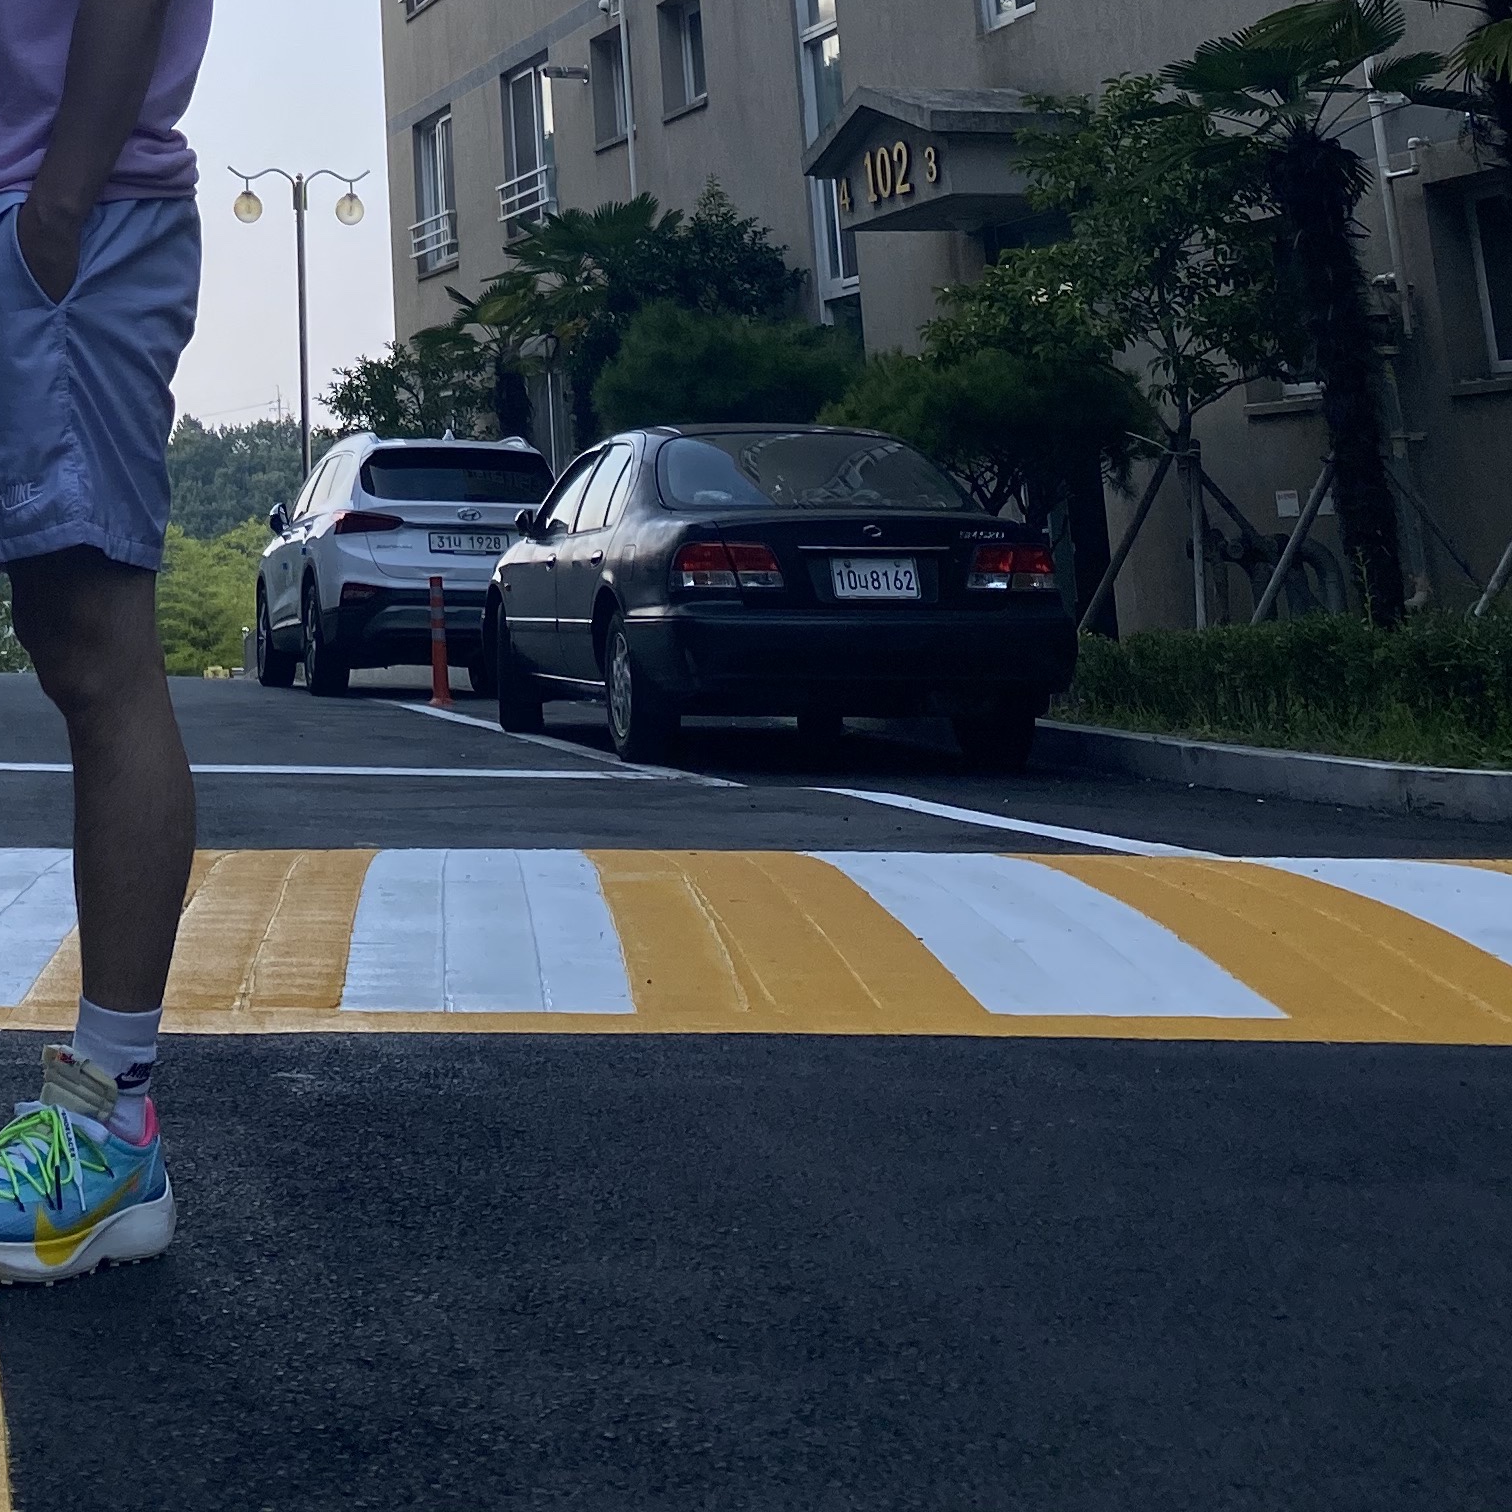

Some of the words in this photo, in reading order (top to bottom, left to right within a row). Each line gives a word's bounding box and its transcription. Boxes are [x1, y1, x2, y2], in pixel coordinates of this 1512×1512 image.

[839, 178, 851, 211] 4
[864, 141, 911, 202] 102
[925, 146, 937, 183] 3
[468, 535, 502, 550] 1928
